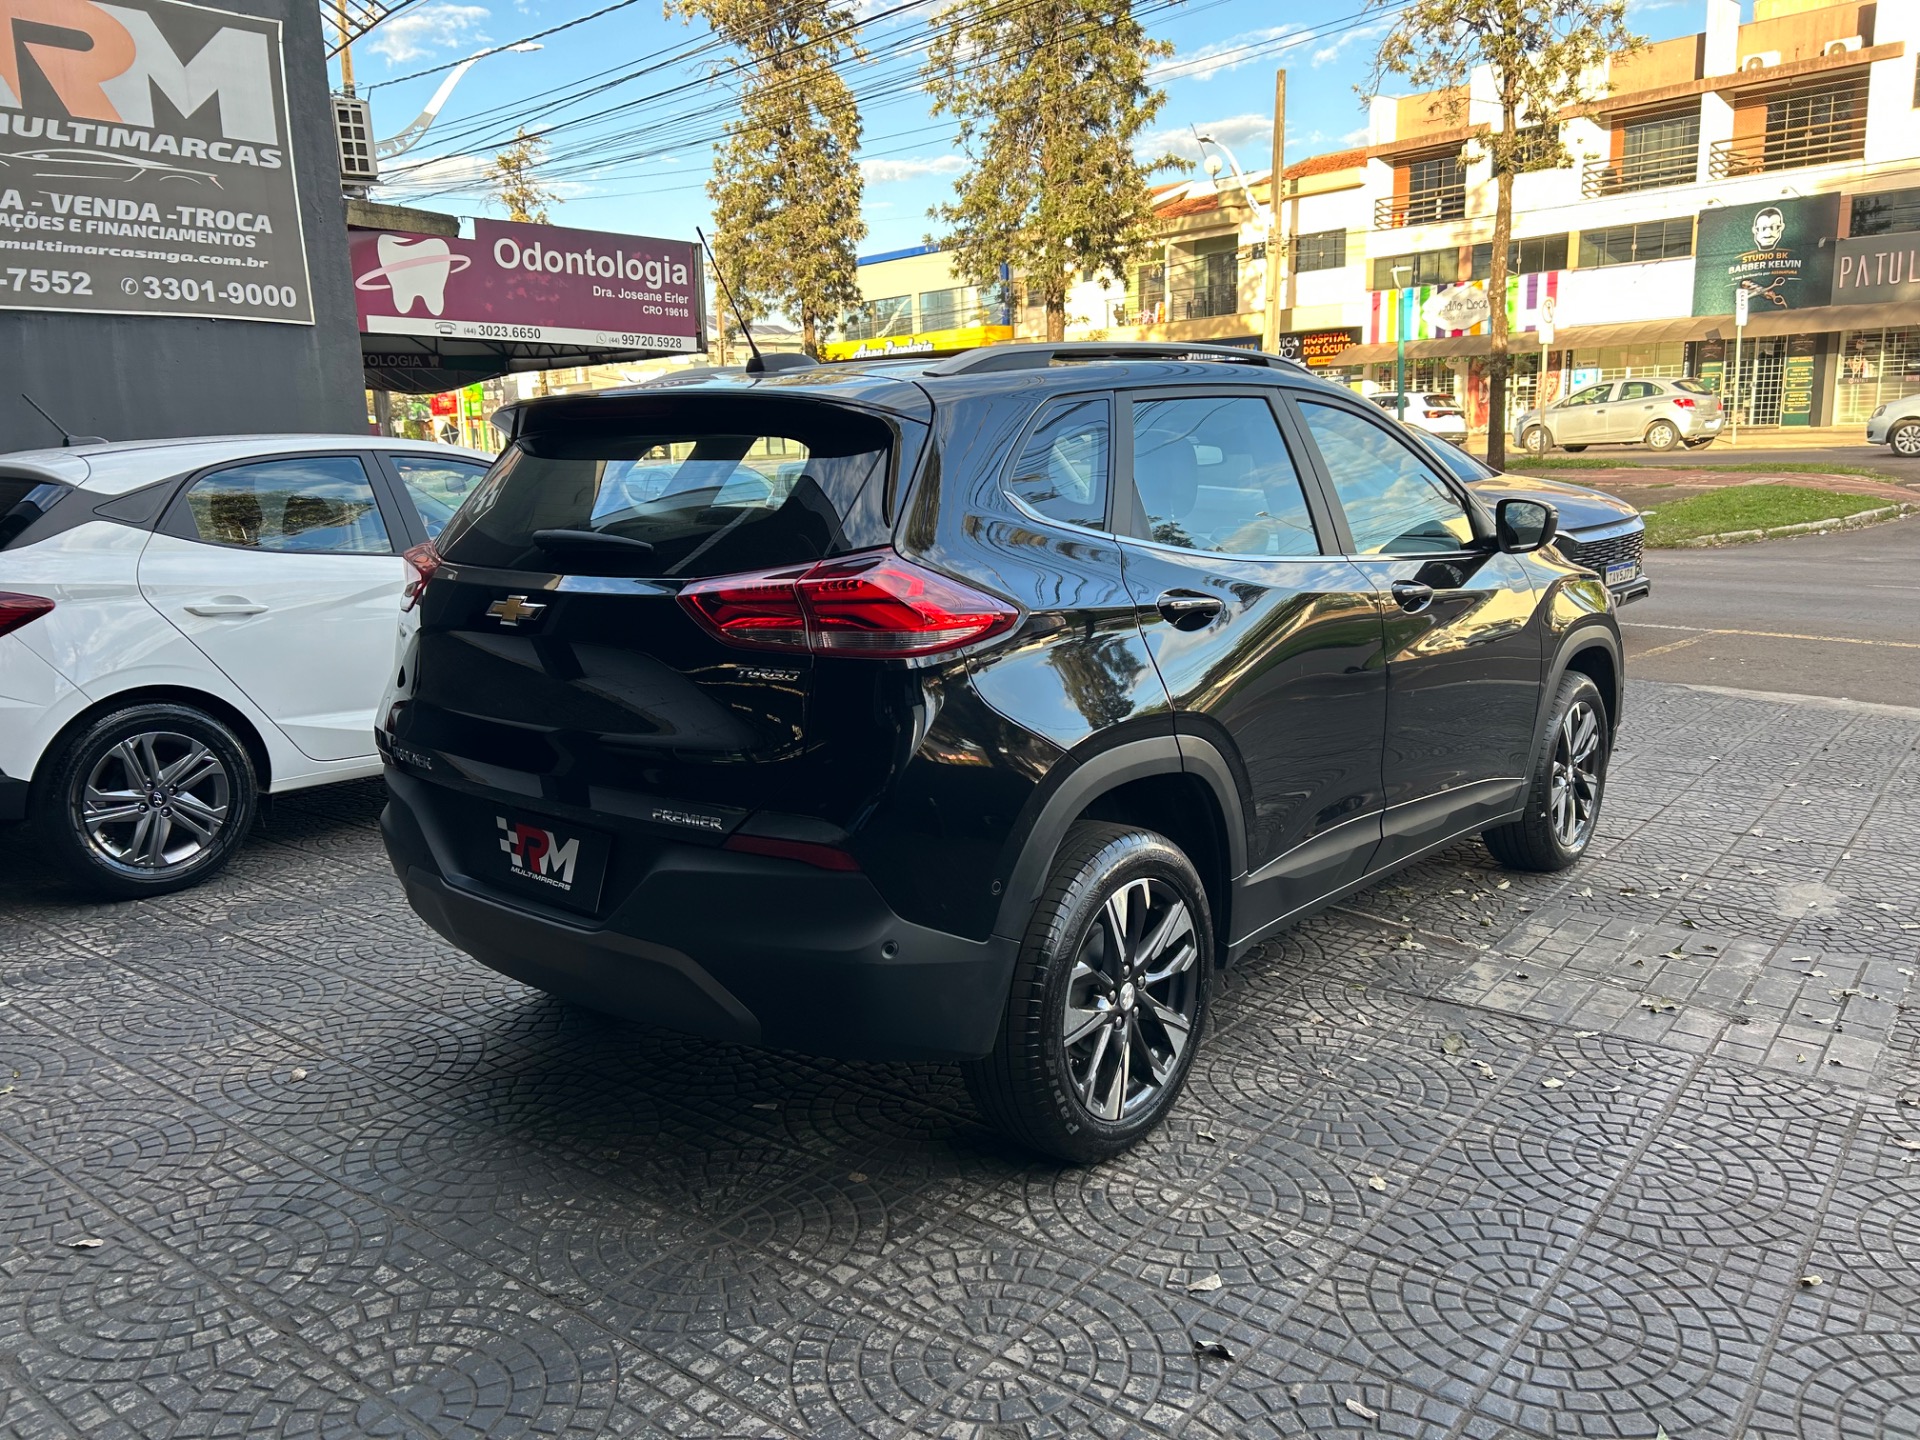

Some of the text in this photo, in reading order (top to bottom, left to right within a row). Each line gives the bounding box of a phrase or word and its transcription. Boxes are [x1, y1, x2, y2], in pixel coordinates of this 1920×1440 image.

[0, 112, 282, 169] ULTIMARCAS
[51, 194, 161, 223] VENDA
[69, 218, 82, 232] E
[86, 220, 256, 248] FINANCIAMENTOS
[493, 237, 688, 290] Odontologia
[1742, 252, 1775, 264] STUDIO
[1728, 259, 1802, 275] BARBER KELVIN
[142, 275, 297, 308] 3301-9000
[592, 285, 689, 304] Dra. Joseane Erler
[642, 305, 689, 317] CRO 19618
[463, 325, 541, 339] (44) 3023.6650
[1303, 332, 1351, 345] HOSPITAL
[621, 334, 682, 349] 99720.5928
[1303, 345, 1321, 355] DOS
[736, 667, 801, 682] TURBO
[652, 808, 723, 831] PREMIER
[510, 865, 572, 891] MULTIMARCAS
